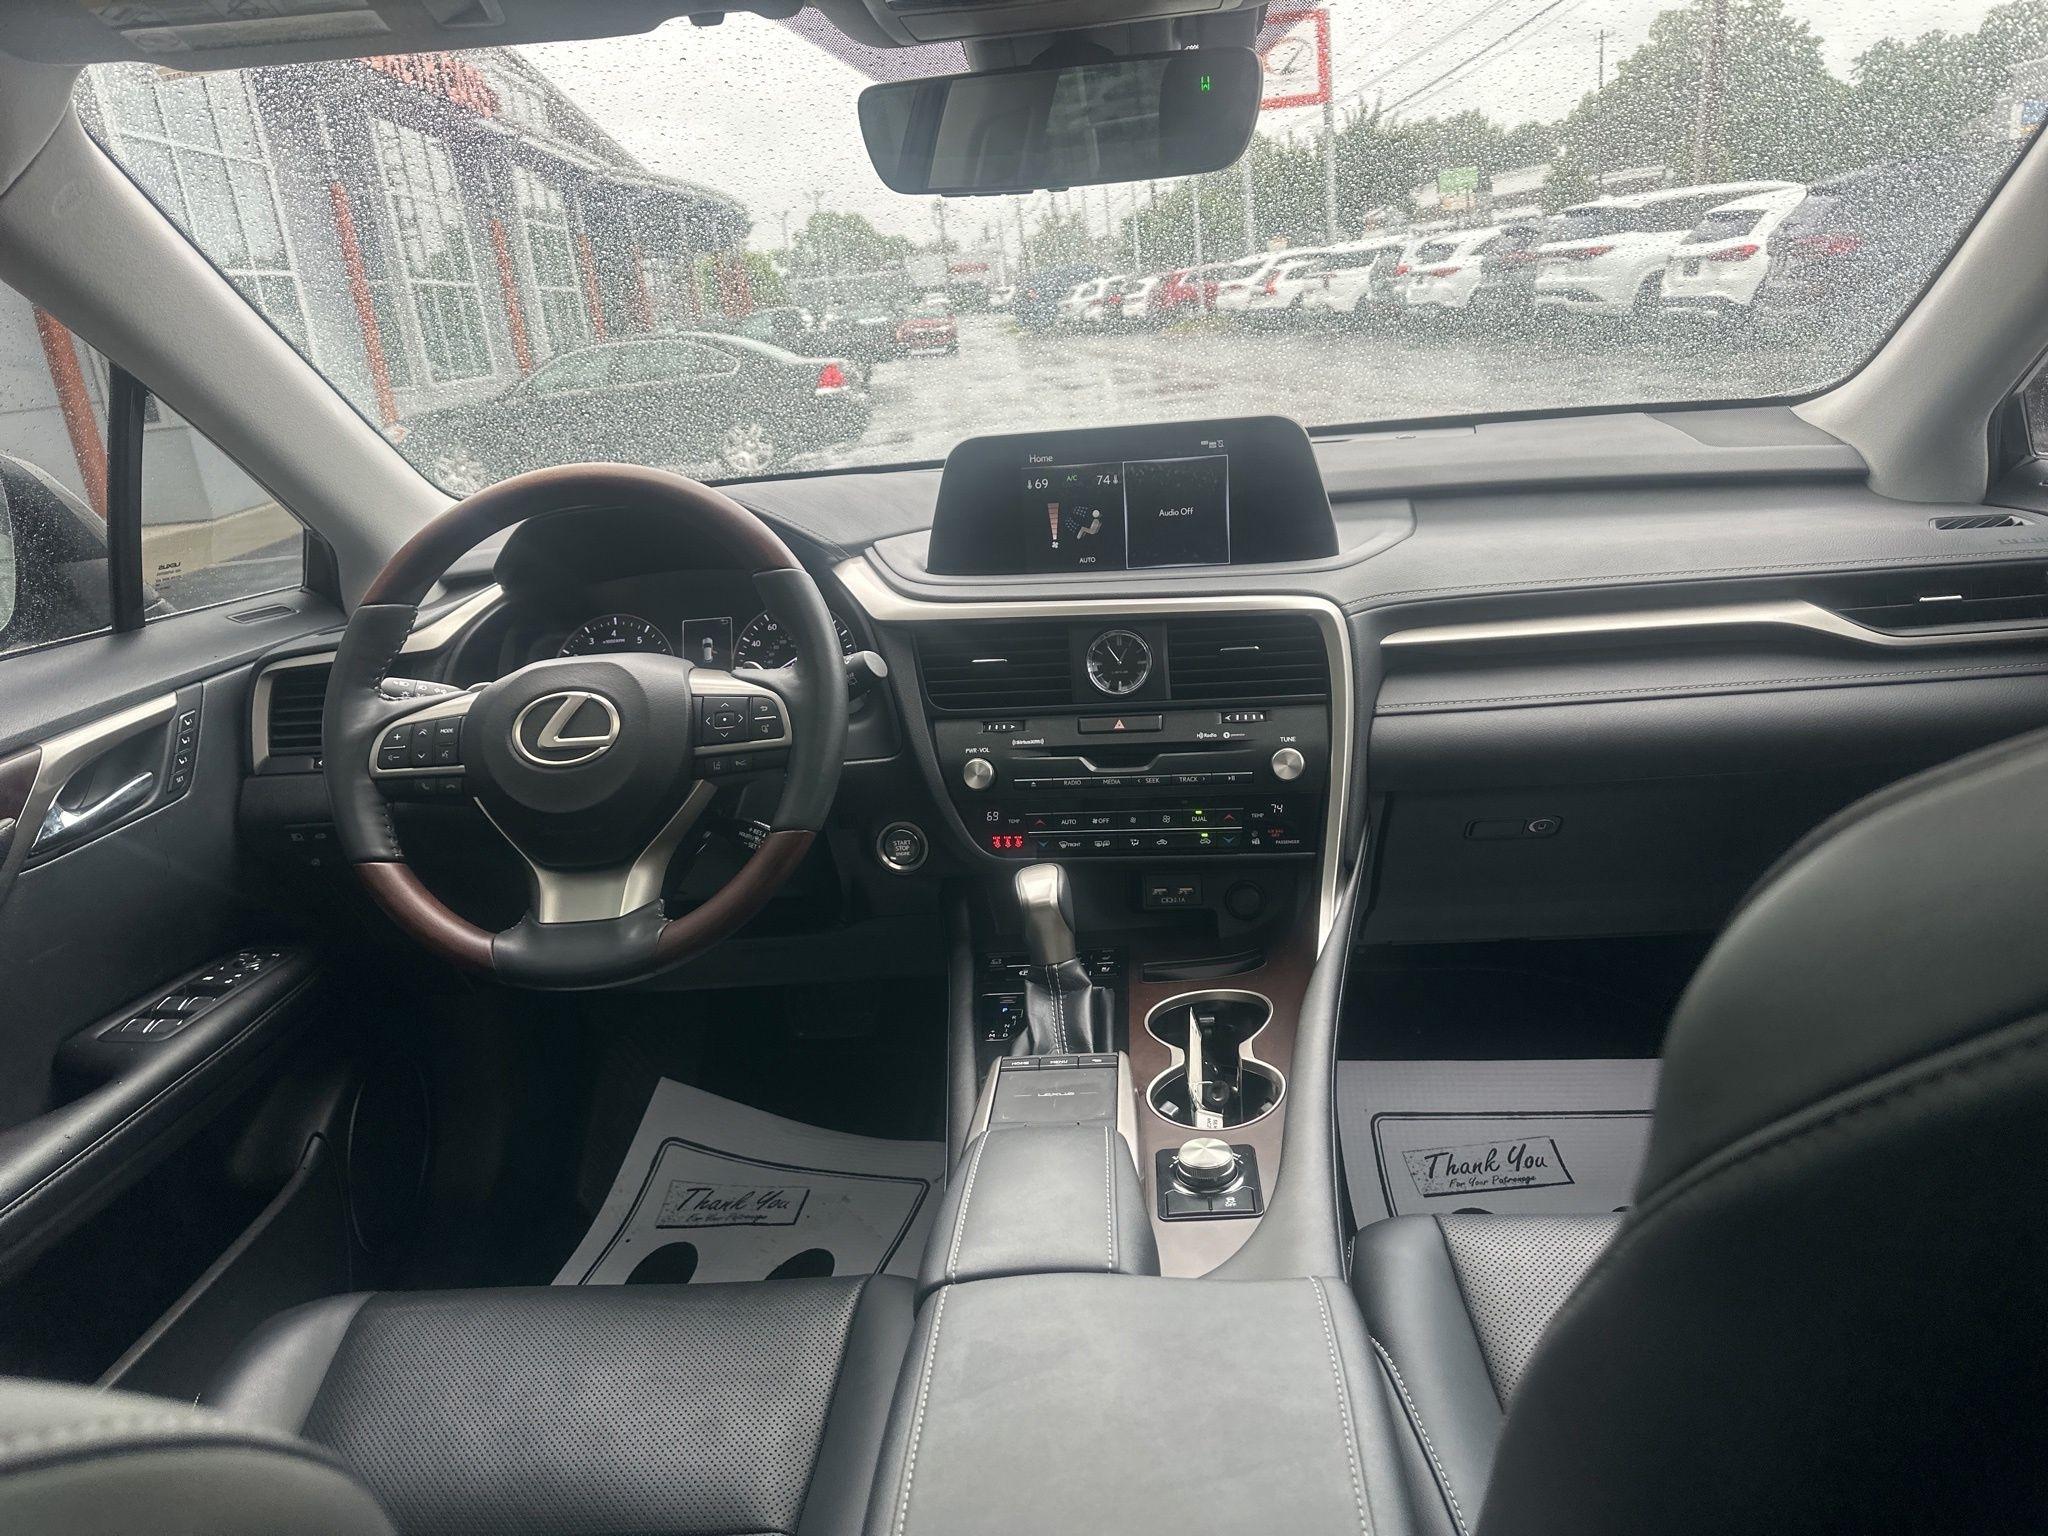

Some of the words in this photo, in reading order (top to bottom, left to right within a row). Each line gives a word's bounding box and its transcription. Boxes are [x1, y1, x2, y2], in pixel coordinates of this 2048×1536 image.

[1029, 453, 1054, 463] Home
[1066, 474, 1078, 482] A/C
[1096, 475, 1111, 486] 74
[1034, 478, 1049, 489] 69
[1159, 508, 1179, 517] Audio
[1180, 506, 1194, 516] Off
[1079, 556, 1096, 564] AUTO
[767, 623, 778, 631] 60
[611, 629, 617, 637] 4
[589, 637, 595, 645] 3
[637, 635, 643, 644] 5
[751, 640, 761, 648] 40
[1179, 775, 1198, 783] TRACK
[1271, 803, 1283, 814] 74
[986, 811, 999, 822] 69
[1191, 815, 1207, 823] DUAL
[893, 839, 911, 847] START
[1423, 1147, 1500, 1179] Thank
[1507, 1143, 1549, 1173] You
[1449, 1179, 1466, 1188] For
[1468, 1177, 1489, 1187] Your
[677, 1187, 756, 1212] Thank
[756, 1189, 790, 1210] You
